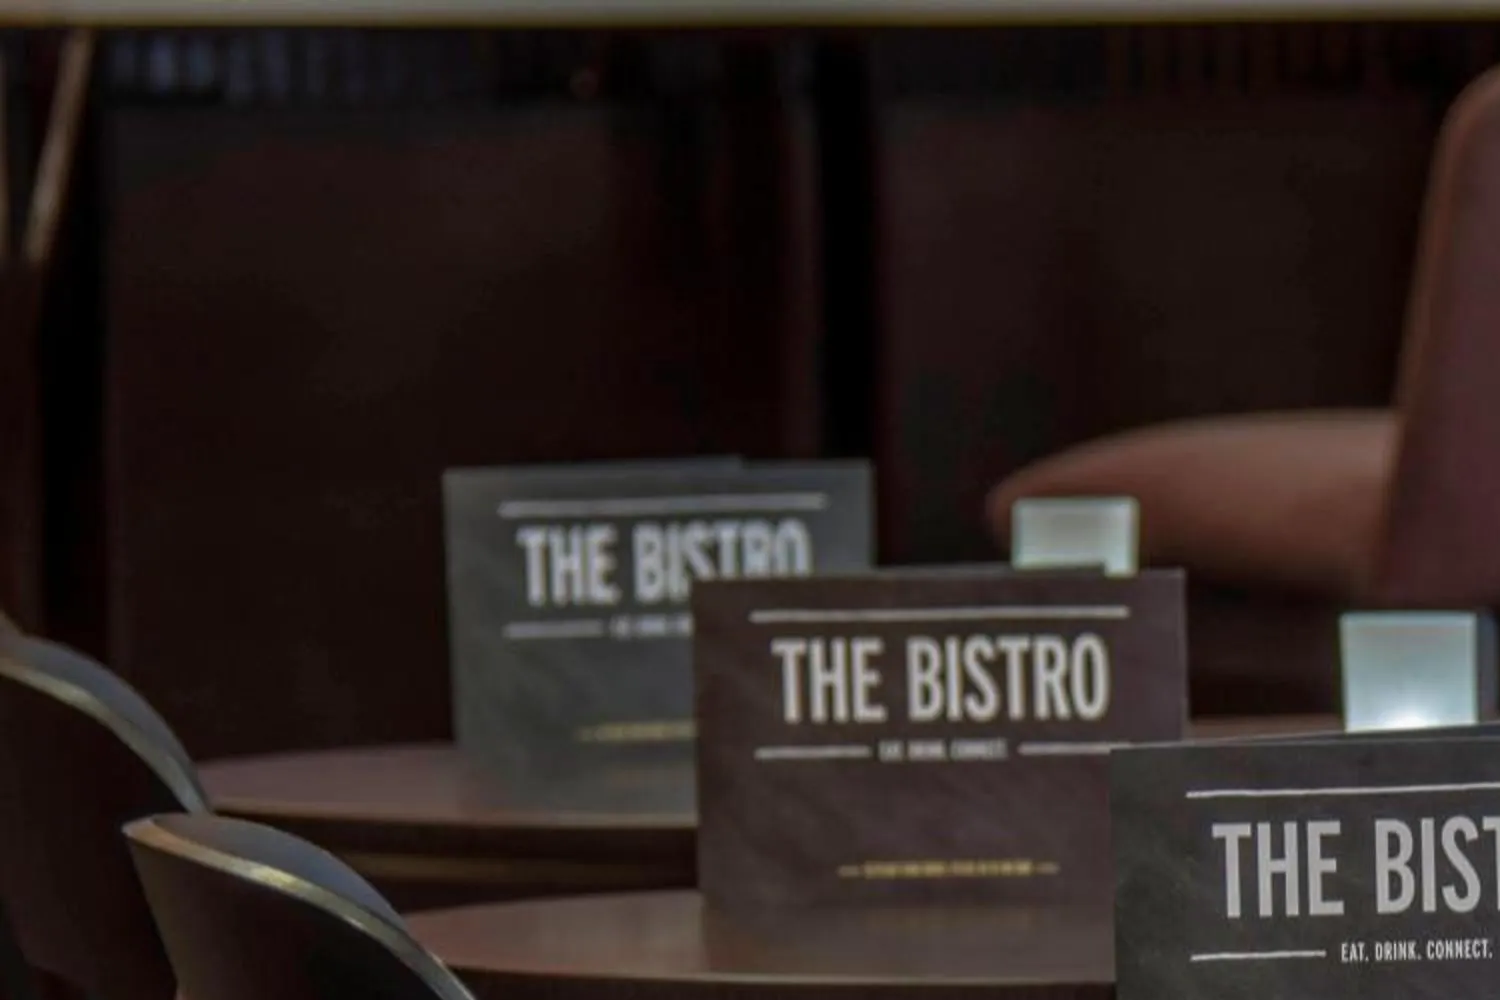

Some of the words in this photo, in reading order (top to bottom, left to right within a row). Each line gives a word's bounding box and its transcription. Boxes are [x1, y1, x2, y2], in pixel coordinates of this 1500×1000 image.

[516, 524, 619, 605] THE
[770, 637, 887, 724] THE
[906, 632, 1110, 722] BISTRO
[1212, 818, 1345, 918] THE
[1341, 942, 1369, 963] EAT.
[1375, 940, 1421, 961] DRINK.
[1427, 938, 1493, 960] CONNECT.
